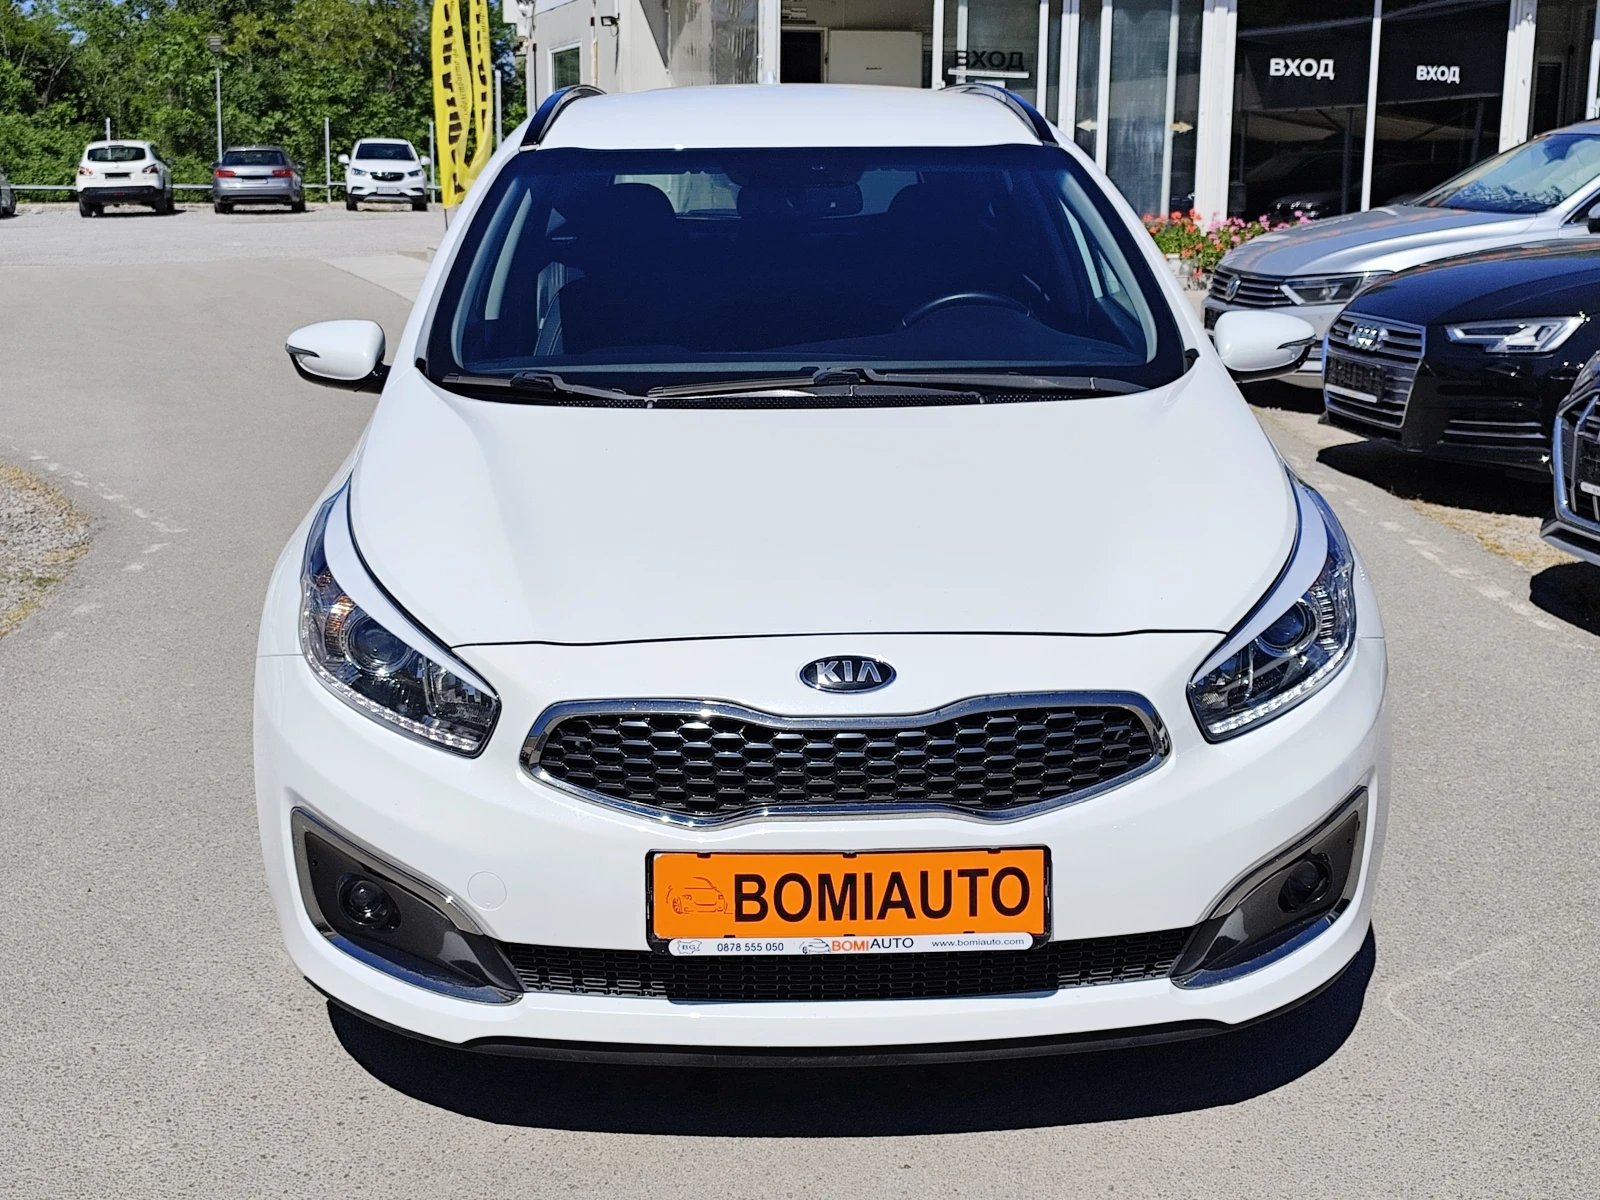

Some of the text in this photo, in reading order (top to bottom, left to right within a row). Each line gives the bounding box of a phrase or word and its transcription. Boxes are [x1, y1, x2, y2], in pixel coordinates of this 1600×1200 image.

[955, 50, 1024, 71] ВХОД
[1269, 58, 1335, 80] ВХОД
[1416, 65, 1460, 84] ВХОД
[815, 660, 882, 684] KIA
[733, 867, 1031, 923] BOMIAUTO
[717, 942, 784, 952] 0878 555 050
[931, 938, 1025, 947] www.bomiauto.com
